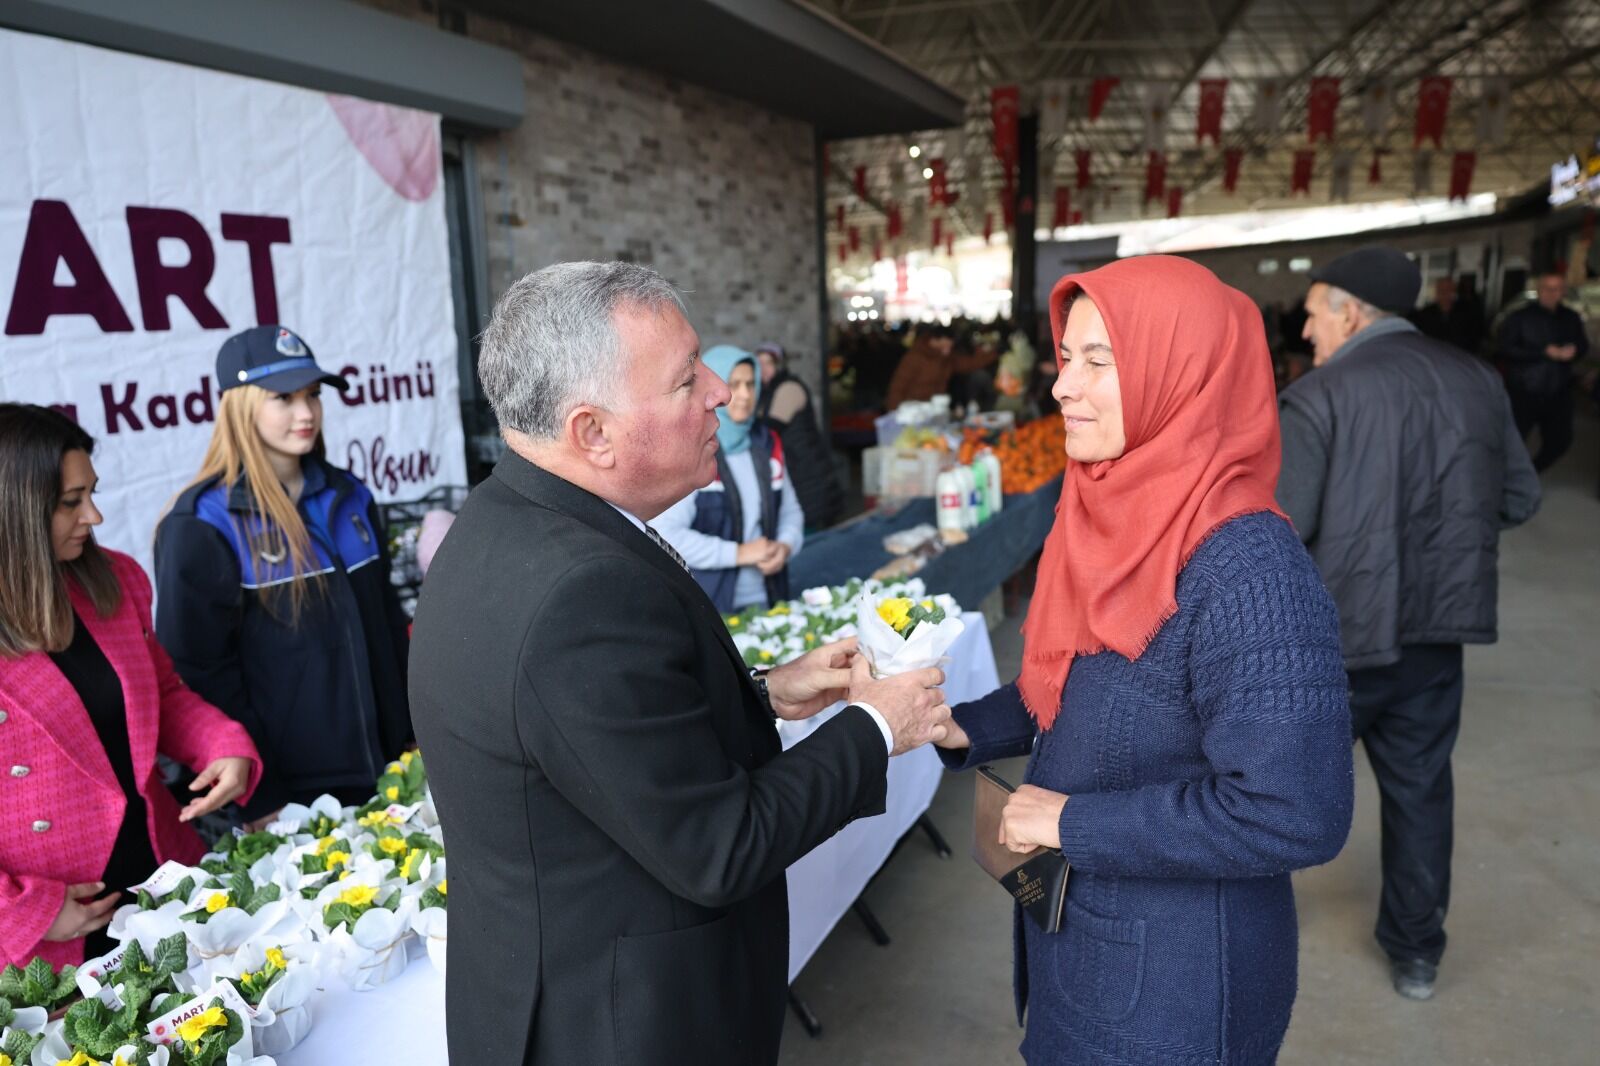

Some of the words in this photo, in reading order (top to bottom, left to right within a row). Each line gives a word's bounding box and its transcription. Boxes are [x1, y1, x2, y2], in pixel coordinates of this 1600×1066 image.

[4, 199, 292, 335] ART
[101, 376, 223, 434] Kad
[337, 361, 435, 406] Günü
[348, 435, 441, 496] Olsun
[102, 952, 126, 971] MAR
[171, 1003, 205, 1027] MART
